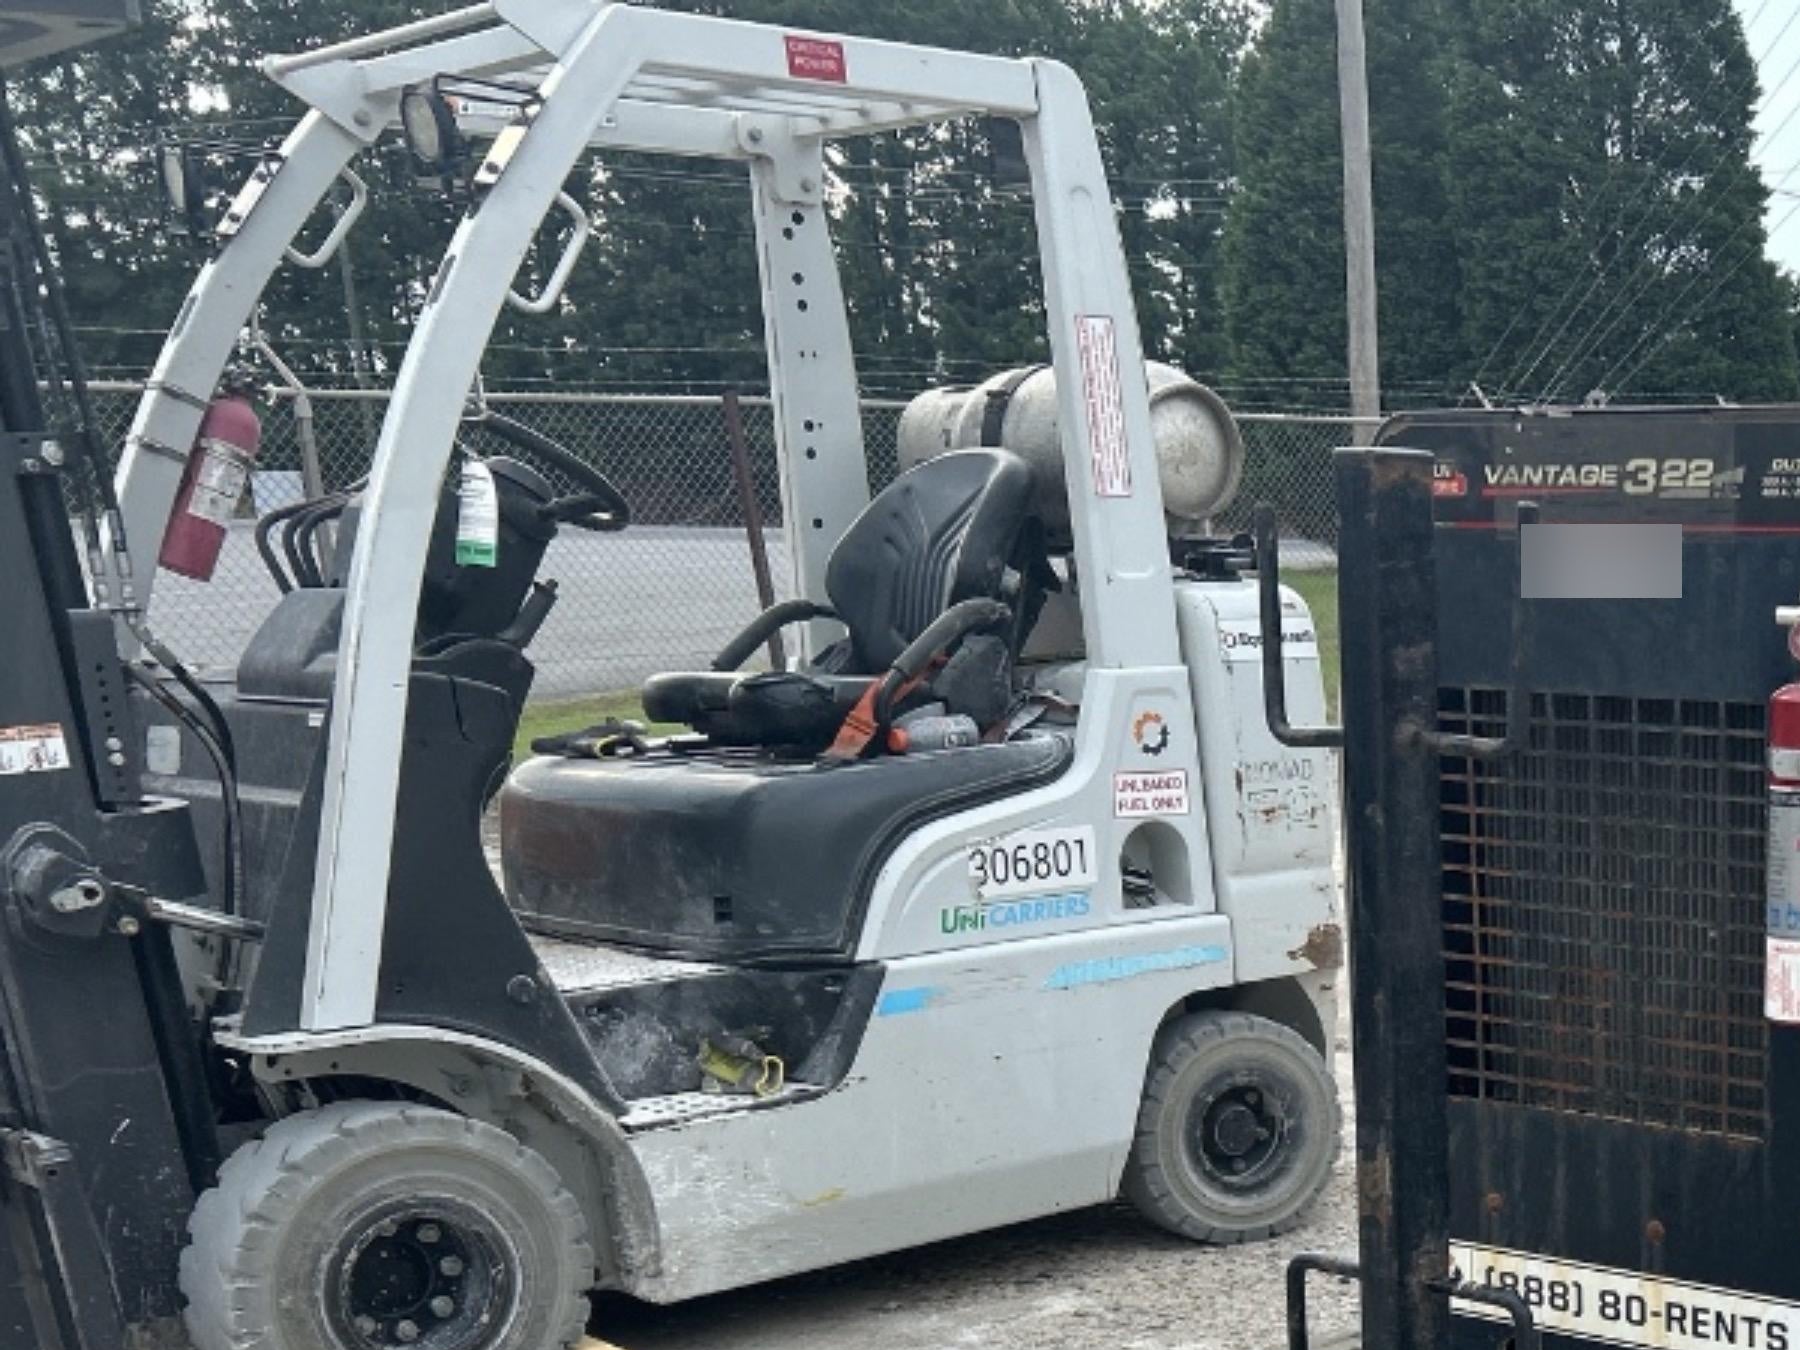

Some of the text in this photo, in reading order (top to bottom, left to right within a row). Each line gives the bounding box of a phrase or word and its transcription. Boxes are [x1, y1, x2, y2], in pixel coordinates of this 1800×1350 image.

[1484, 463, 1620, 487] VANTAGE
[1623, 458, 1714, 496] 322
[969, 839, 1088, 887] 306801
